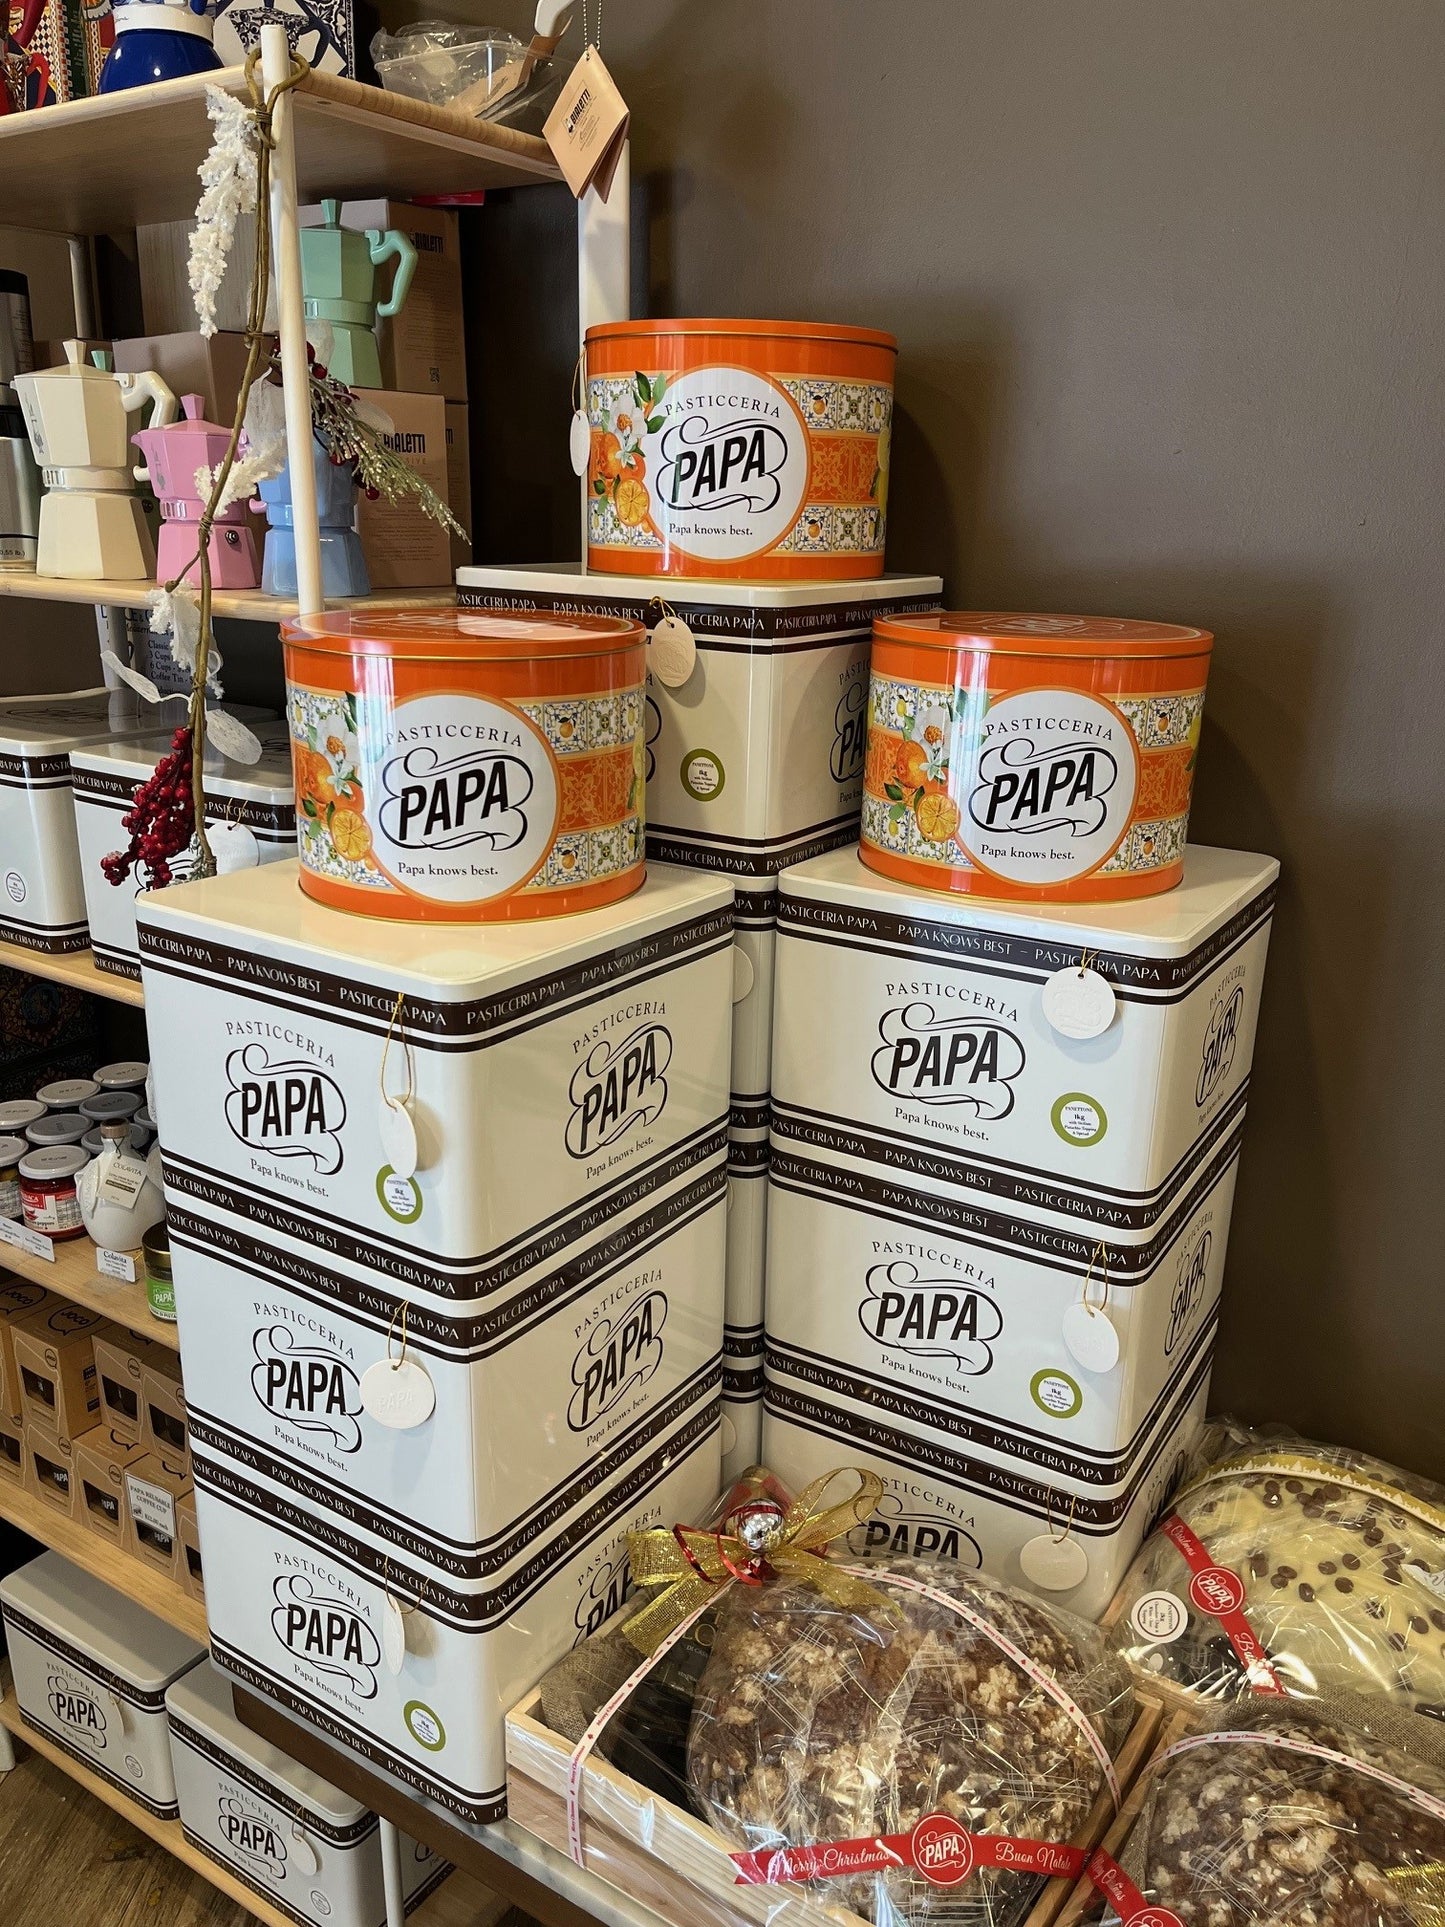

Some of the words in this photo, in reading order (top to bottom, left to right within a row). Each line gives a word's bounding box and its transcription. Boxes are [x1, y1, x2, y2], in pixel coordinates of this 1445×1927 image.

[664, 395, 780, 418] PASTICCERIA
[671, 430, 768, 503] PAPA
[669, 523, 691, 535] Papa
[693, 523, 727, 535] knows
[730, 524, 753, 536] best.
[775, 613, 819, 630] PASTICCERIA
[820, 612, 837, 625] PAPA
[386, 724, 522, 747] PASTICCERIA
[986, 717, 1113, 741] PASTICCERIA
[105, 781, 124, 793] PAPA
[399, 761, 509, 841] PAPA
[986, 752, 1095, 825] PAPA
[398, 862, 425, 877] Papa
[428, 862, 467, 876] knows
[470, 862, 498, 875] best.
[660, 846, 724, 867] PASTICCERIA
[725, 857, 755, 872] PAPA
[766, 851, 808, 871] PASTICCERIA
[980, 844, 1007, 857] Papa
[1010, 846, 1047, 859] knows
[1050, 847, 1074, 860] best.
[779, 901, 845, 925] PASTICCERIA
[847, 914, 878, 931] PAPA
[898, 924, 929, 941] PAPA
[932, 929, 981, 951] KNOWS
[983, 939, 1012, 955] BEST
[1035, 948, 1119, 975] PASTICERIA
[1122, 963, 1160, 982] PAPA
[186, 945, 212, 963] PAPA
[228, 956, 255, 977] PAPA
[255, 962, 296, 986] KNOWS
[298, 974, 321, 994] BEST
[412, 1006, 447, 1027] PAPA
[466, 989, 538, 1025] PASTICCERIA
[538, 980, 566, 1002] PAPA
[581, 963, 606, 985] PAPA
[606, 950, 642, 974] KNOWS
[640, 941, 660, 963] BEST
[672, 919, 720, 948] PASTICCERIA
[886, 982, 1019, 1022] PASTICCERIA
[226, 1020, 336, 1068] PASTICCERIA
[573, 1001, 667, 1054] PASTICCERIA
[1199, 993, 1240, 1101] PAPA
[889, 1030, 998, 1089] PAPA
[241, 1076, 327, 1138] PAPA
[580, 1031, 657, 1153] PAPA
[894, 1107, 921, 1125] Papa
[923, 1113, 961, 1135] knows
[963, 1124, 990, 1142] best.
[250, 1157, 273, 1178] Papa
[274, 1167, 305, 1189] knows
[306, 1179, 329, 1198] best.
[585, 1160, 606, 1179] Papa
[608, 1146, 634, 1167] knows
[635, 1135, 654, 1154] best.
[772, 1117, 835, 1146] PASTICCERIA
[837, 1135, 866, 1154] PAPA
[885, 1149, 916, 1168] PAPA
[917, 1157, 964, 1182] KNOWS
[966, 1170, 994, 1189] BEST
[1014, 1184, 1094, 1217] PASTICCERIA
[1096, 1206, 1133, 1225] PAPA
[103, 1250, 127, 1264] Colavita
[209, 1189, 235, 1209] PAPA
[249, 1204, 274, 1224] PAPA
[276, 1214, 315, 1243] KNOWS
[316, 1231, 338, 1250] BEST
[356, 1247, 422, 1283] PASTICCERIA
[423, 1274, 456, 1295] PAPA
[871, 1241, 997, 1290] PASTICCERIA
[61, 1311, 89, 1325] JOCO
[575, 1268, 663, 1338] PASTICCERIA
[875, 1291, 978, 1341] PAPA
[253, 1302, 356, 1360] PASTICCERIA
[581, 1299, 654, 1426] PAPA
[881, 1354, 906, 1373] Papa
[908, 1362, 944, 1385] knows
[945, 1374, 971, 1394] best.
[267, 1358, 347, 1416] PAPA
[586, 1426, 606, 1448] Papa
[607, 1408, 631, 1431] knows
[632, 1393, 650, 1412] best.
[274, 1424, 295, 1444] Papa
[297, 1438, 325, 1462] knows
[327, 1453, 349, 1473] best.
[865, 1519, 960, 1560] PAPA
[274, 1552, 372, 1617] PASTICCERIA
[1199, 1577, 1232, 1605] PAPA
[287, 1602, 363, 1665] PAPA
[46, 1662, 99, 1702] PASTICCERIA
[293, 1663, 315, 1685] Papa
[316, 1677, 343, 1701] knows
[344, 1694, 365, 1715] best.
[55, 1692, 98, 1730] PAPA
[218, 1782, 281, 1832] PASTICCERIA
[227, 1814, 276, 1858] PAPA
[823, 1847, 891, 1871] Christmas
[925, 1835, 960, 1866] PAPA
[995, 1841, 1034, 1864] Buon
[1037, 1846, 1071, 1871] Natale
